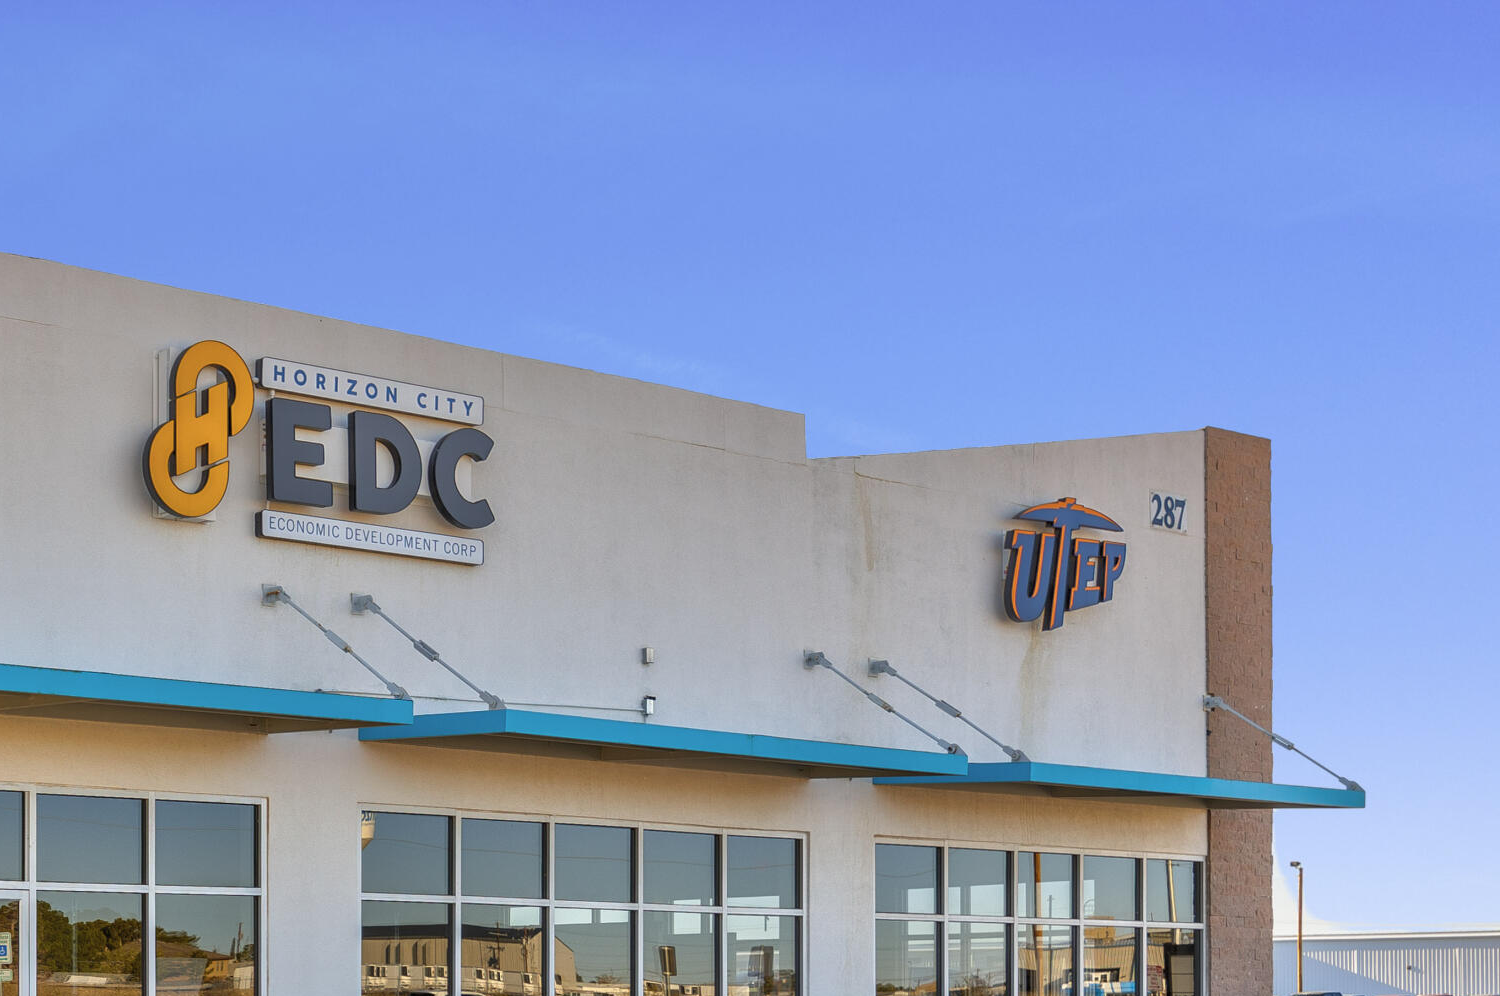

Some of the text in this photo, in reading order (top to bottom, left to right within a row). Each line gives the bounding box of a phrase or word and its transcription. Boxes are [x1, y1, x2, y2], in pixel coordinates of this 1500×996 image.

[272, 364, 475, 417] HORIZON CITY
[267, 397, 496, 530] EDC
[268, 515, 478, 558] ECONOMIC DEVELOPMENT CORP
[1151, 493, 1187, 531] 287
[1004, 497, 1127, 632] UTEP
